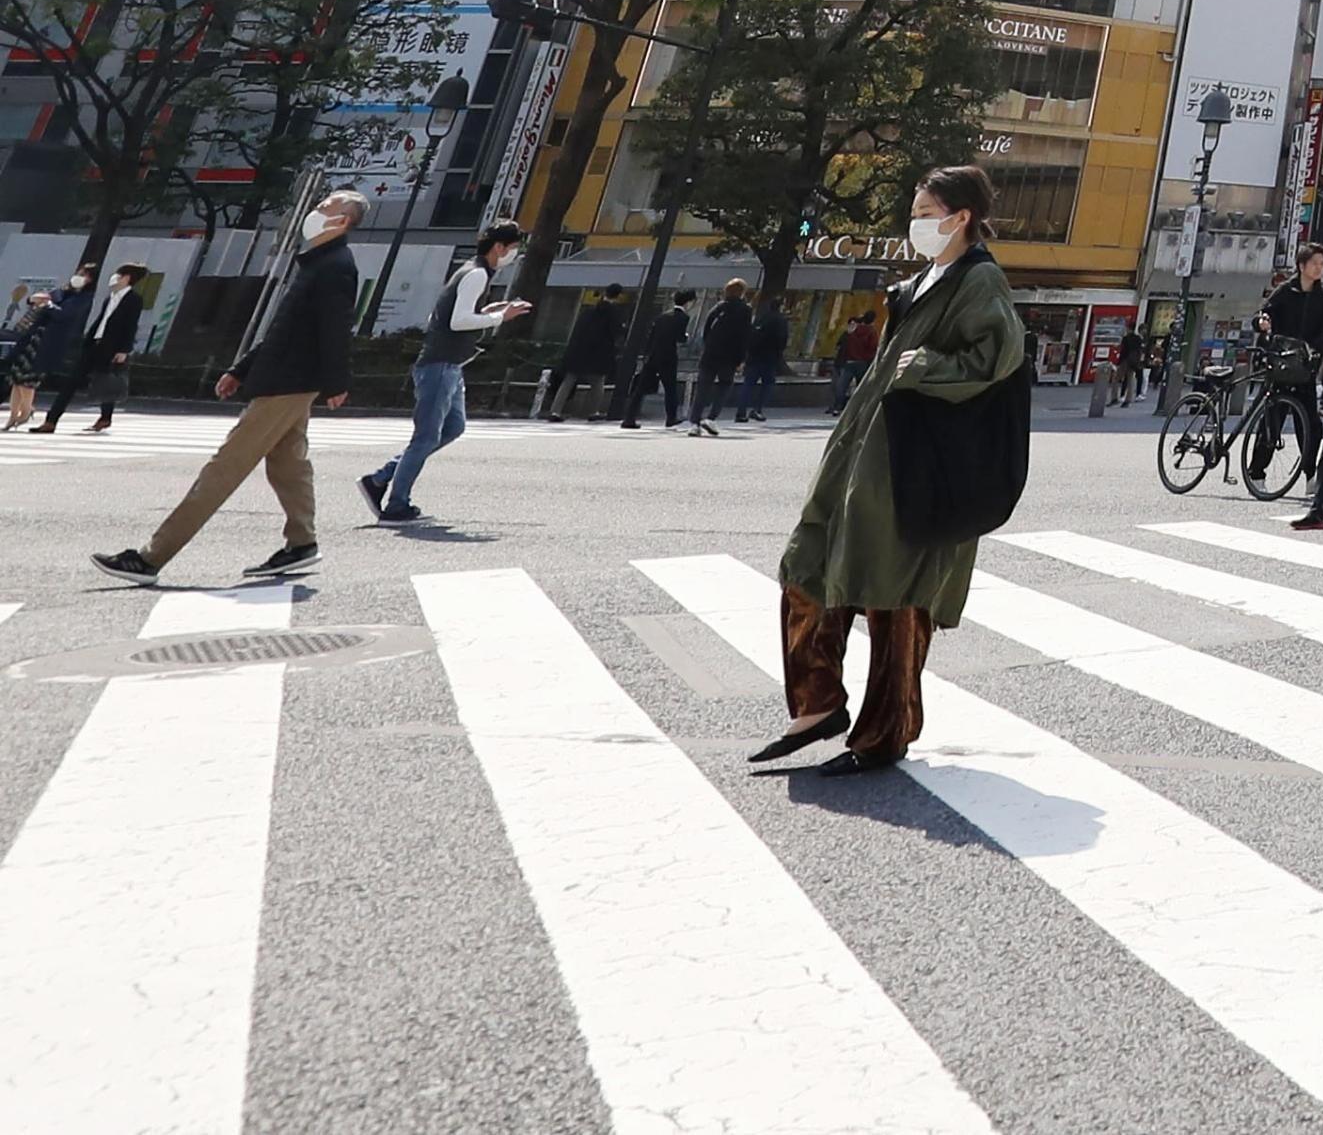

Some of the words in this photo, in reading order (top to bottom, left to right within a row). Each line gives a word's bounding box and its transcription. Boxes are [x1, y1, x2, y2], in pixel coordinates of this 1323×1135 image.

[985, 16, 1068, 43] CCITANE
[1186, 98, 1274, 120] デ製作中
